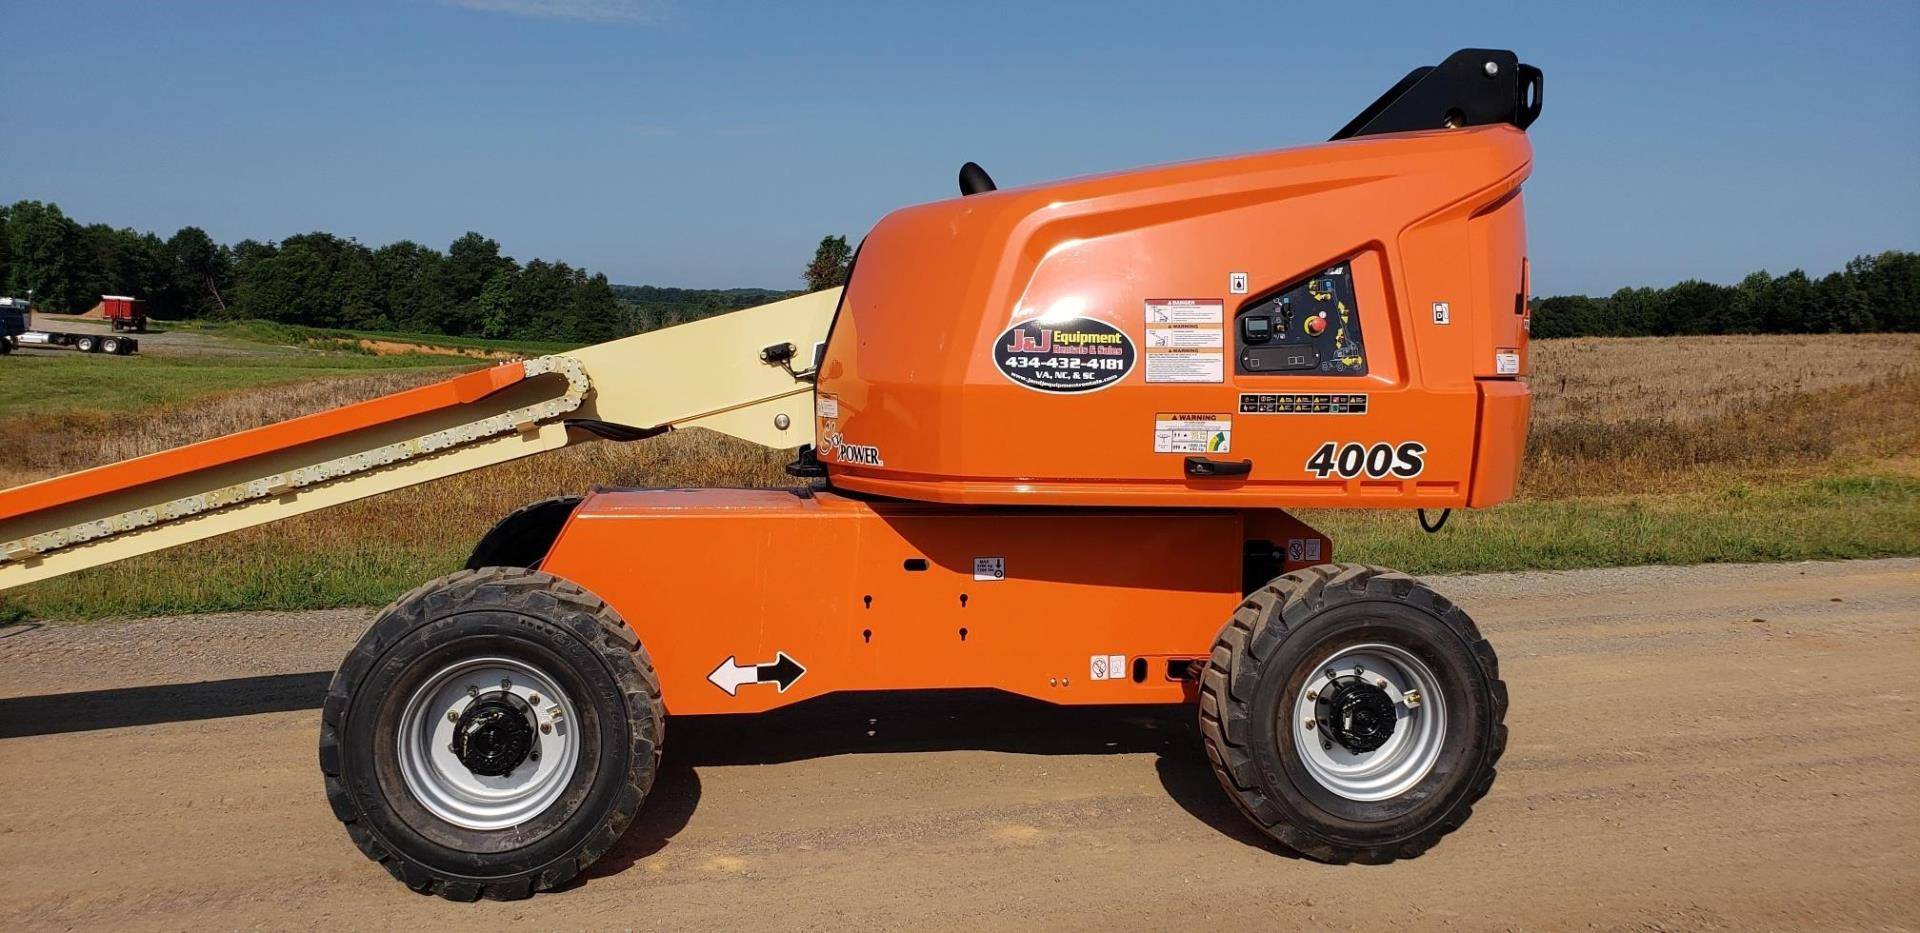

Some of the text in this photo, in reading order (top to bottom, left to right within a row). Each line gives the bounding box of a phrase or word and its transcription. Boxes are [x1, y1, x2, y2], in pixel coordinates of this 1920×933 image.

[1053, 330, 1122, 345] Equipment
[1005, 356, 1124, 370] 434-432-4181
[1035, 371, 1095, 380] VA, NC, & SC
[840, 445, 879, 465] POWER
[1305, 441, 1426, 478] 400S
